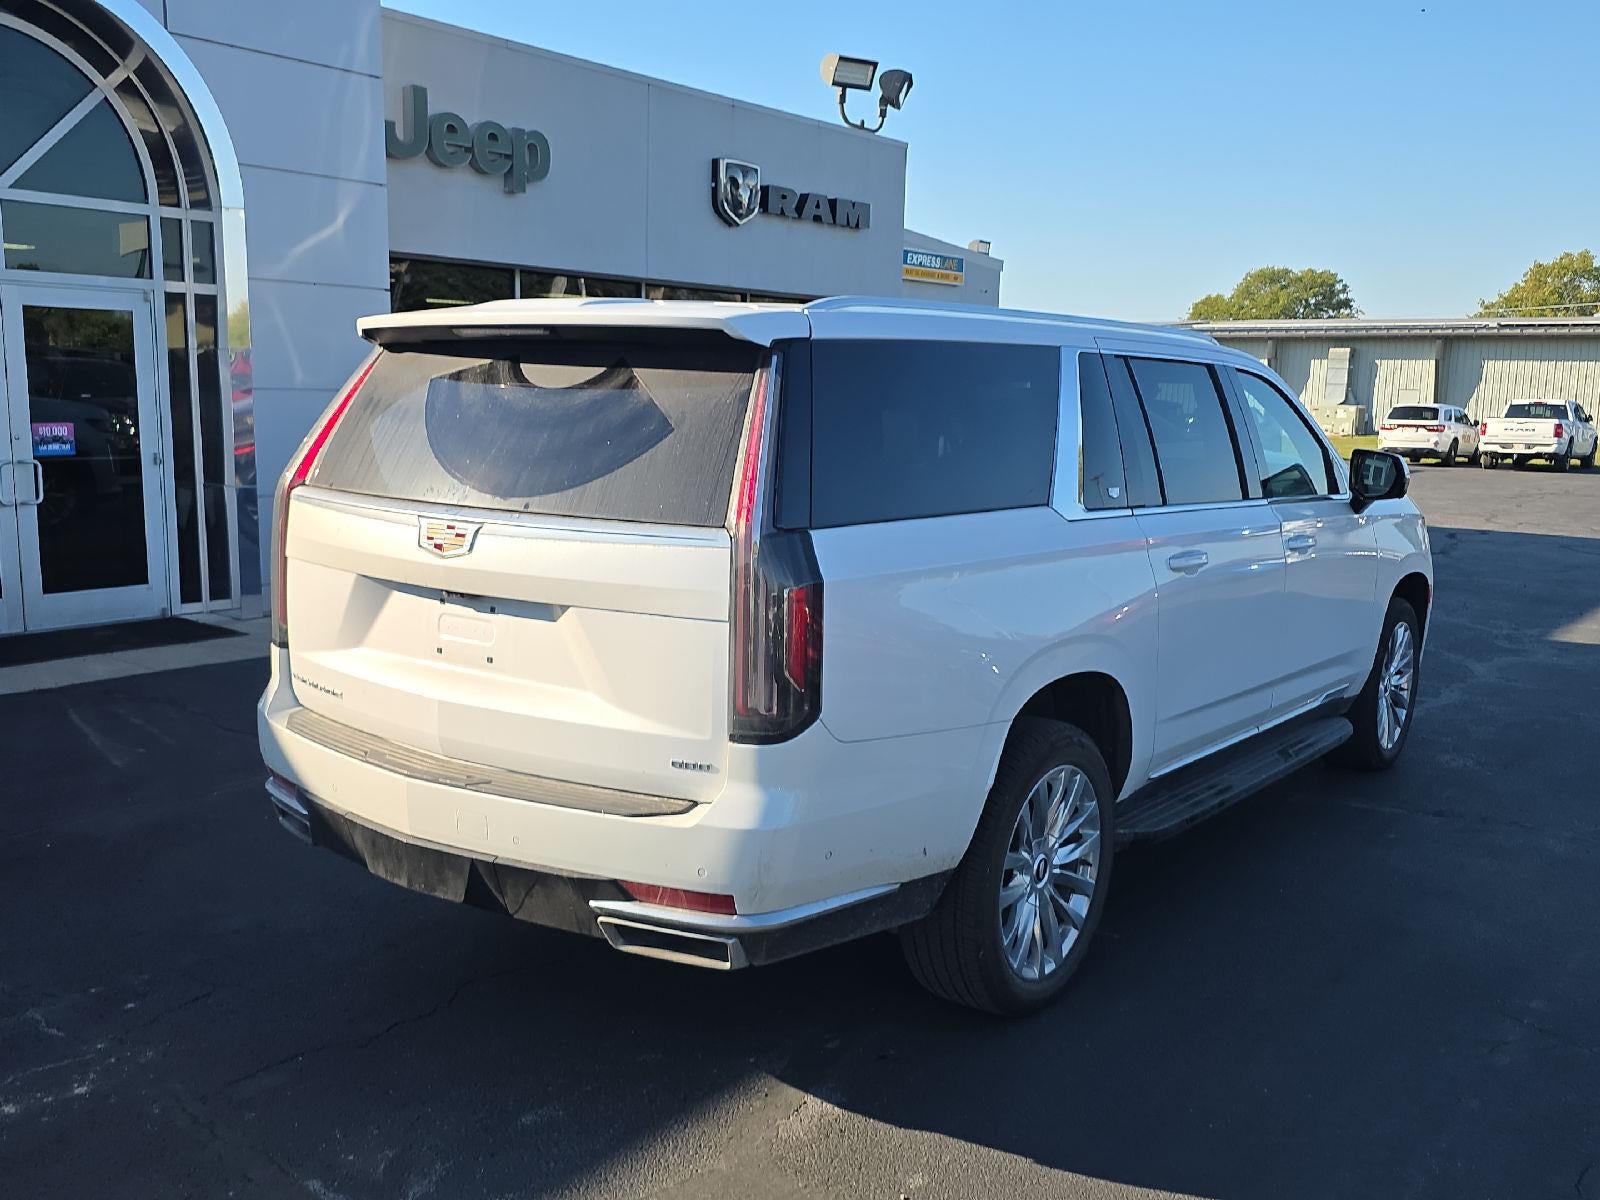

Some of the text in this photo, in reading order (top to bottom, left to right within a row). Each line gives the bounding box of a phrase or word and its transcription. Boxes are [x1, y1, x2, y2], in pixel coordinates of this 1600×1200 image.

[384, 84, 551, 195] Jeep
[760, 184, 871, 229] RAM
[906, 252, 940, 268] EXPRESS
